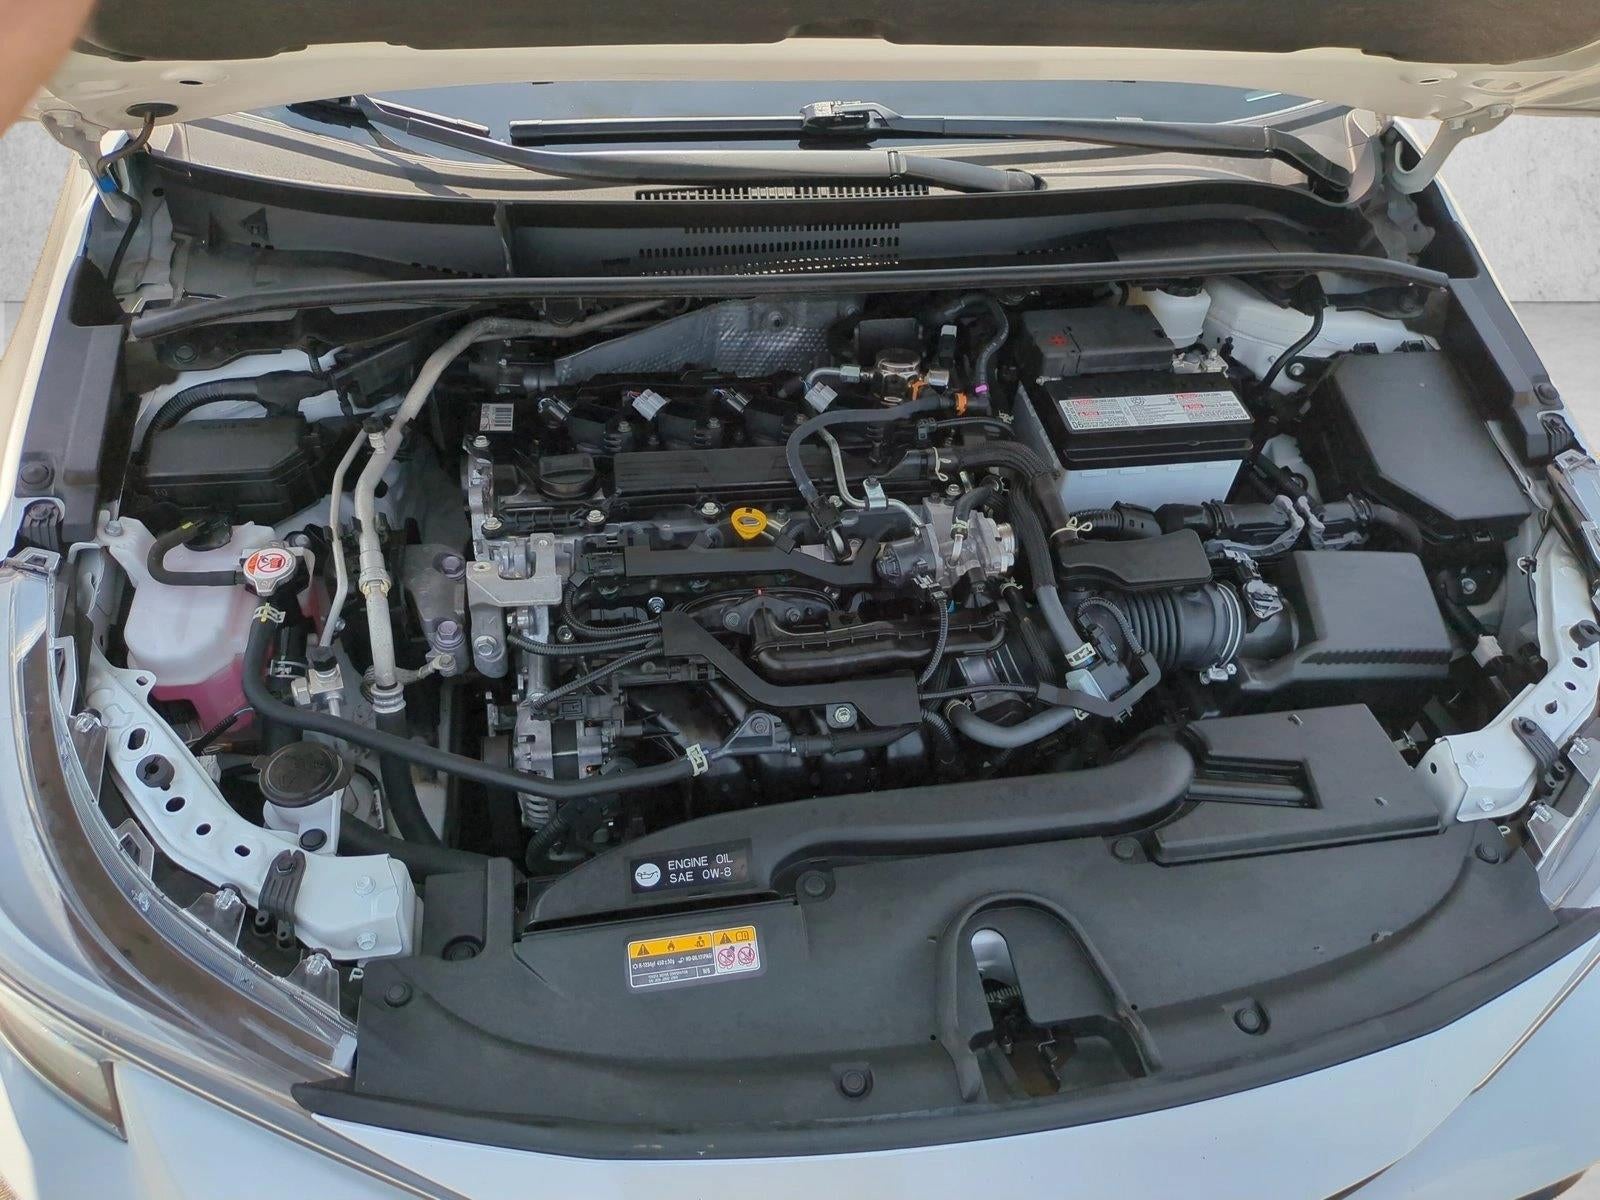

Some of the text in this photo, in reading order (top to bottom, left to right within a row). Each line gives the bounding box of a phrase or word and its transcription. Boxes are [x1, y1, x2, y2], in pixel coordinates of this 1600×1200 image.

[667, 853, 734, 871] ENGINE OIL
[669, 871, 694, 883] SAE
